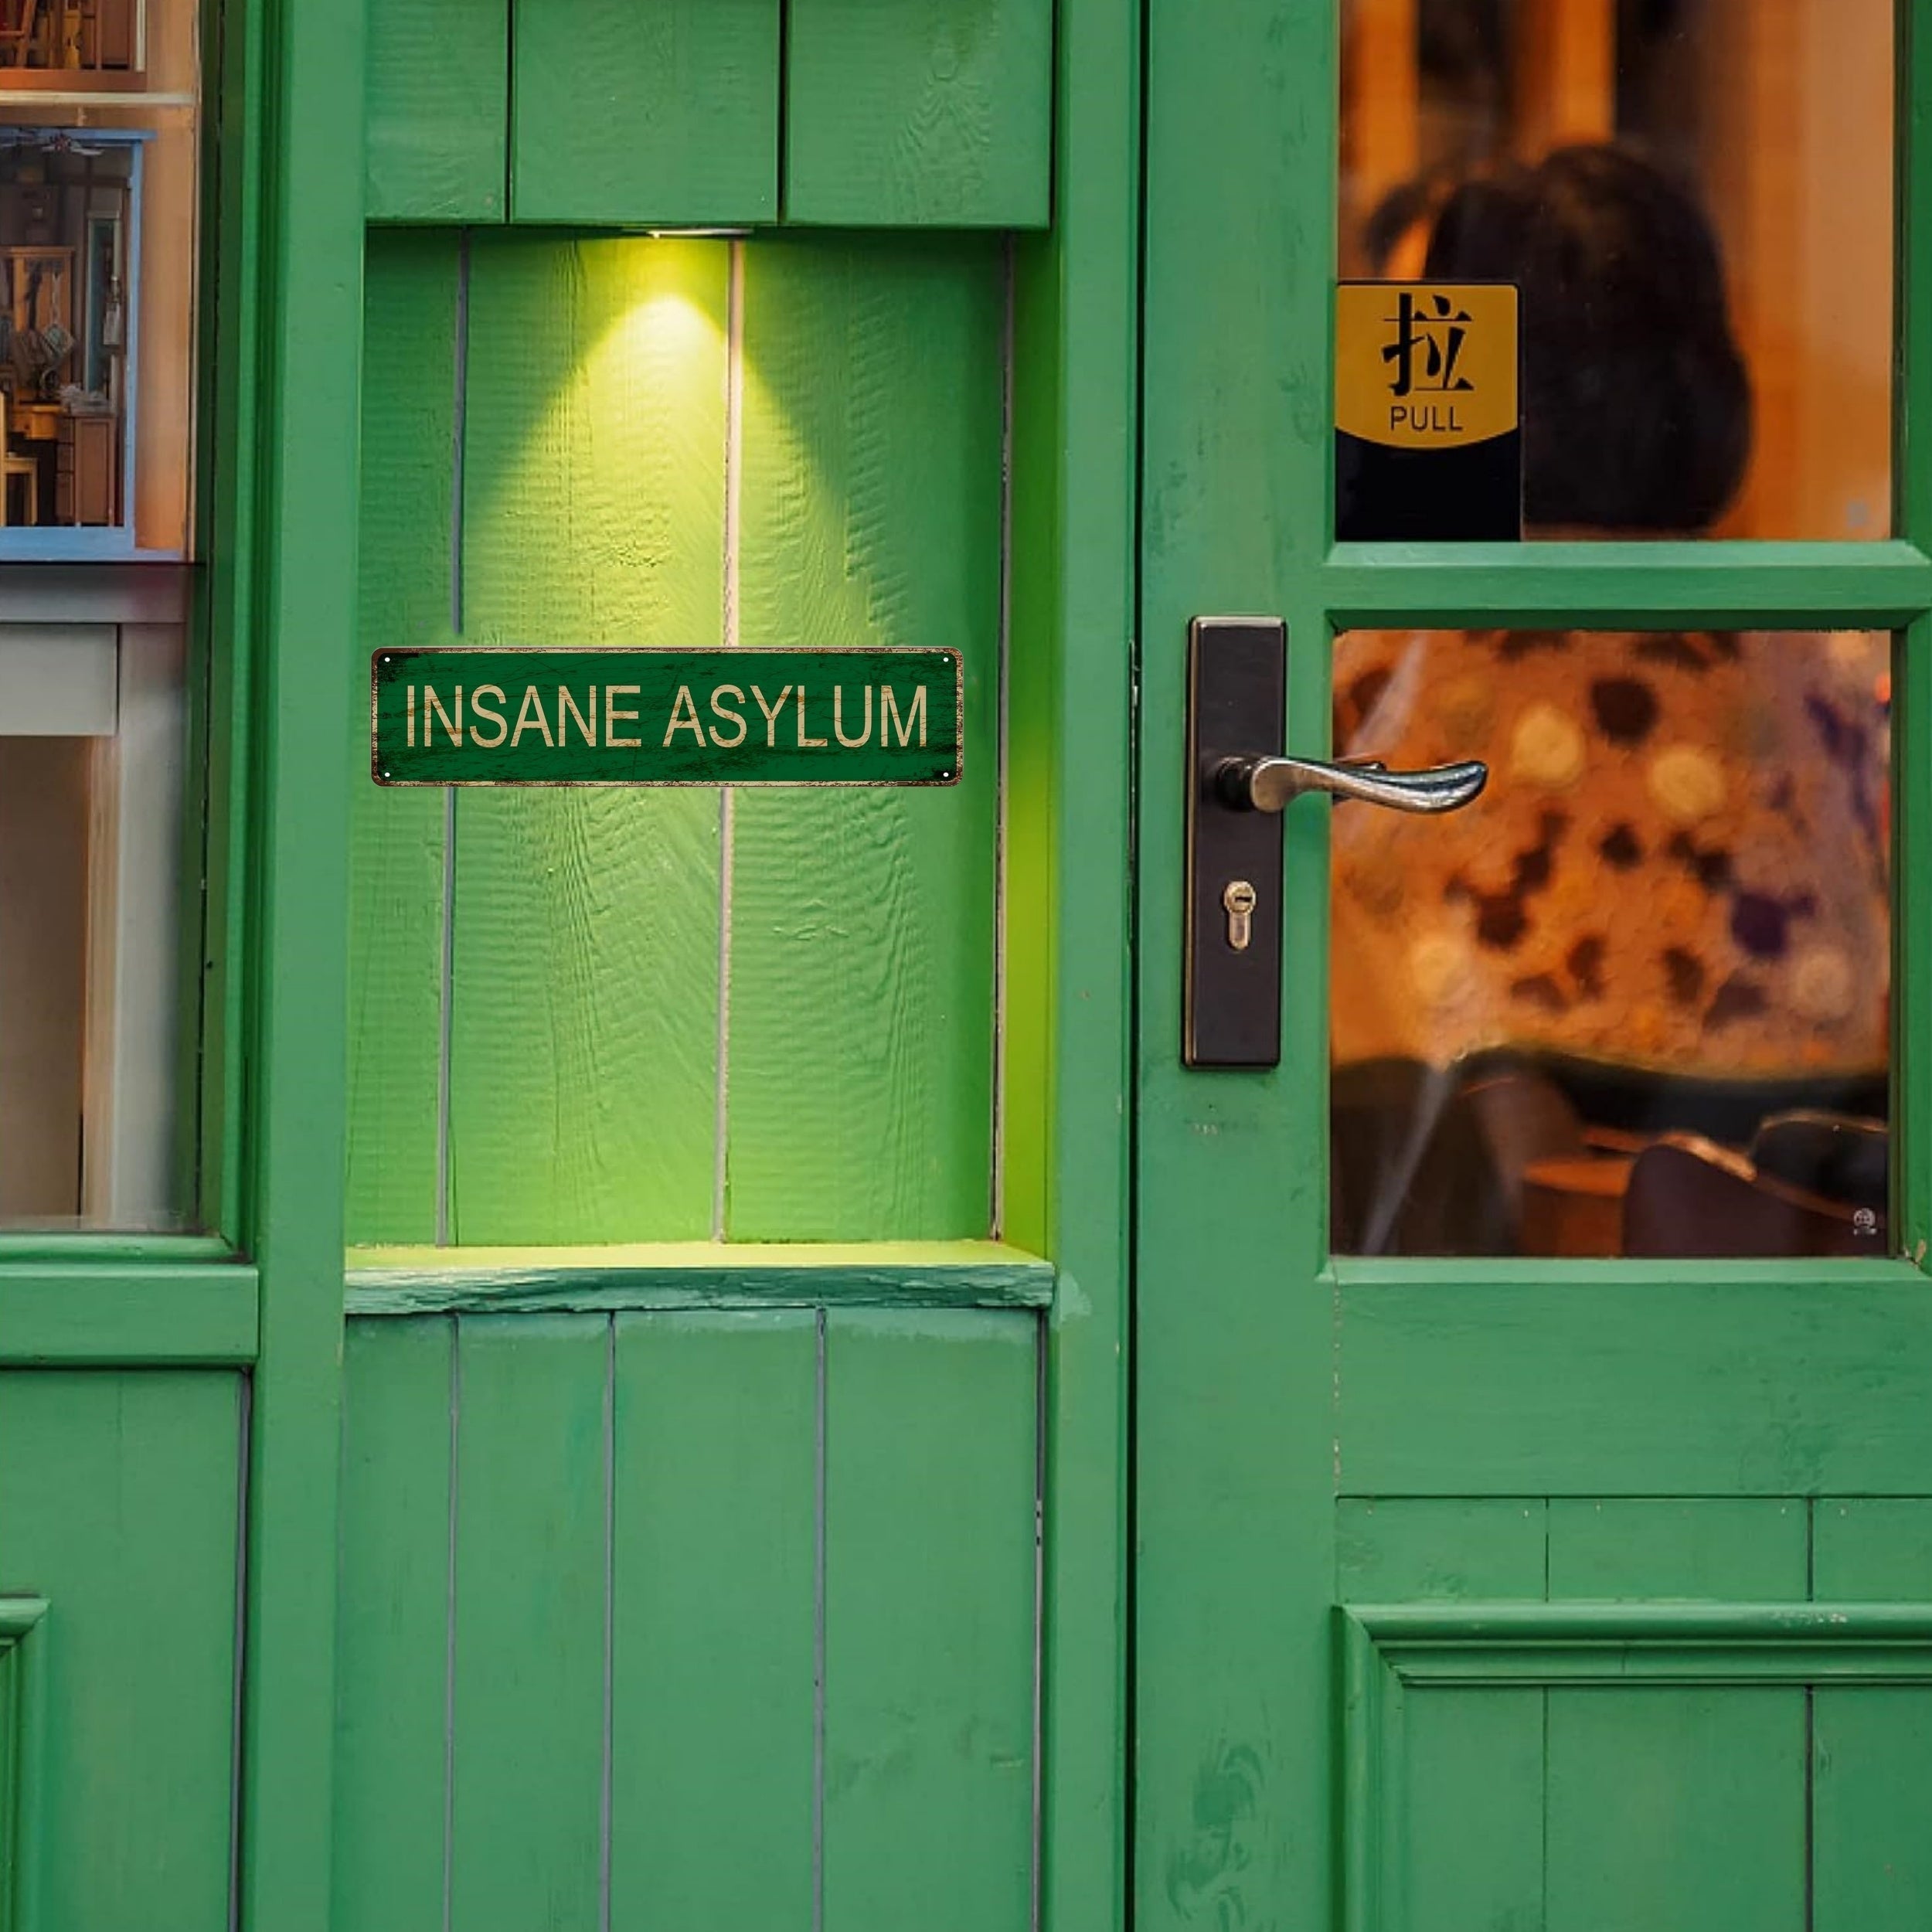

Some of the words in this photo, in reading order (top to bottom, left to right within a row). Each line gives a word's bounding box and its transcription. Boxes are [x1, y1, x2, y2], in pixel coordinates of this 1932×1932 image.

[1382, 292, 1475, 396] 拉
[1390, 406, 1464, 431] PULL
[406, 684, 642, 748] INSANE
[662, 684, 928, 748] ASYLUM
